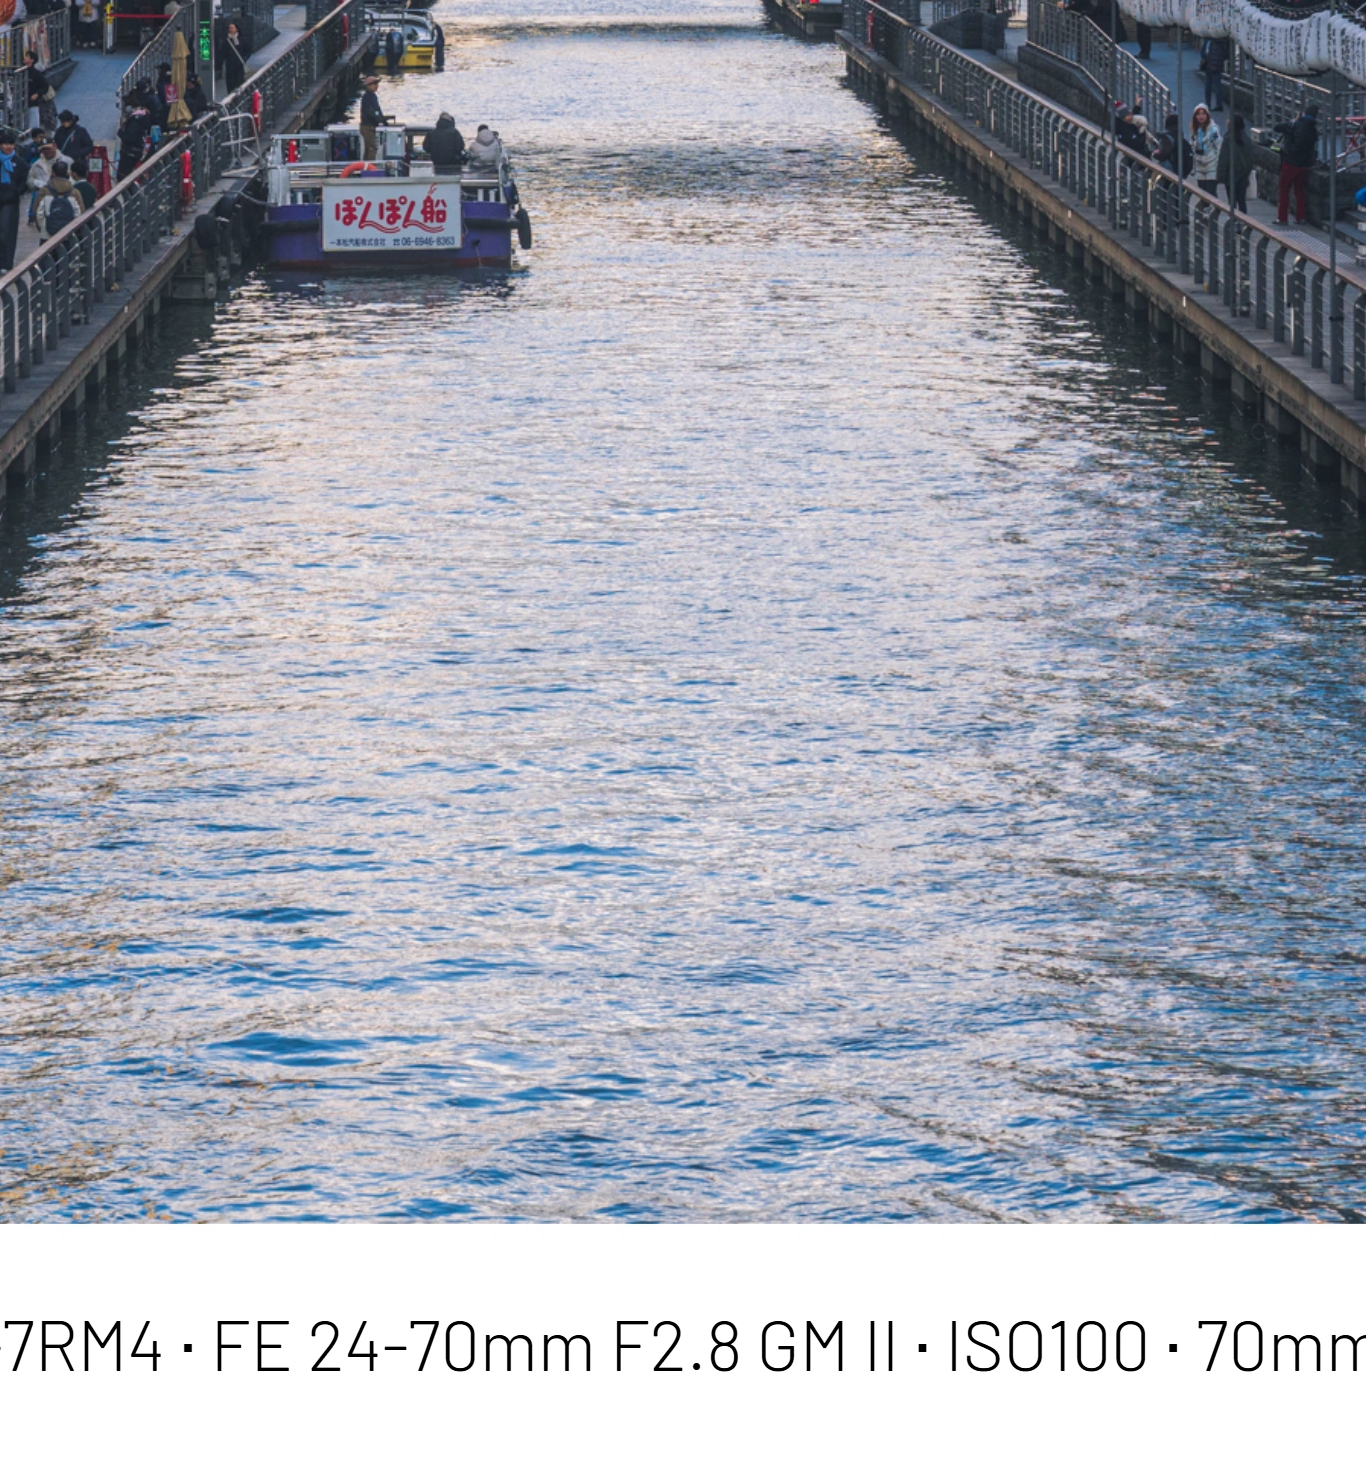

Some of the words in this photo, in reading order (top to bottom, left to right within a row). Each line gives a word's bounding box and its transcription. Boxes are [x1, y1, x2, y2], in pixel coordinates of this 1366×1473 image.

[334, 193, 448, 234] ぽんぽん船
